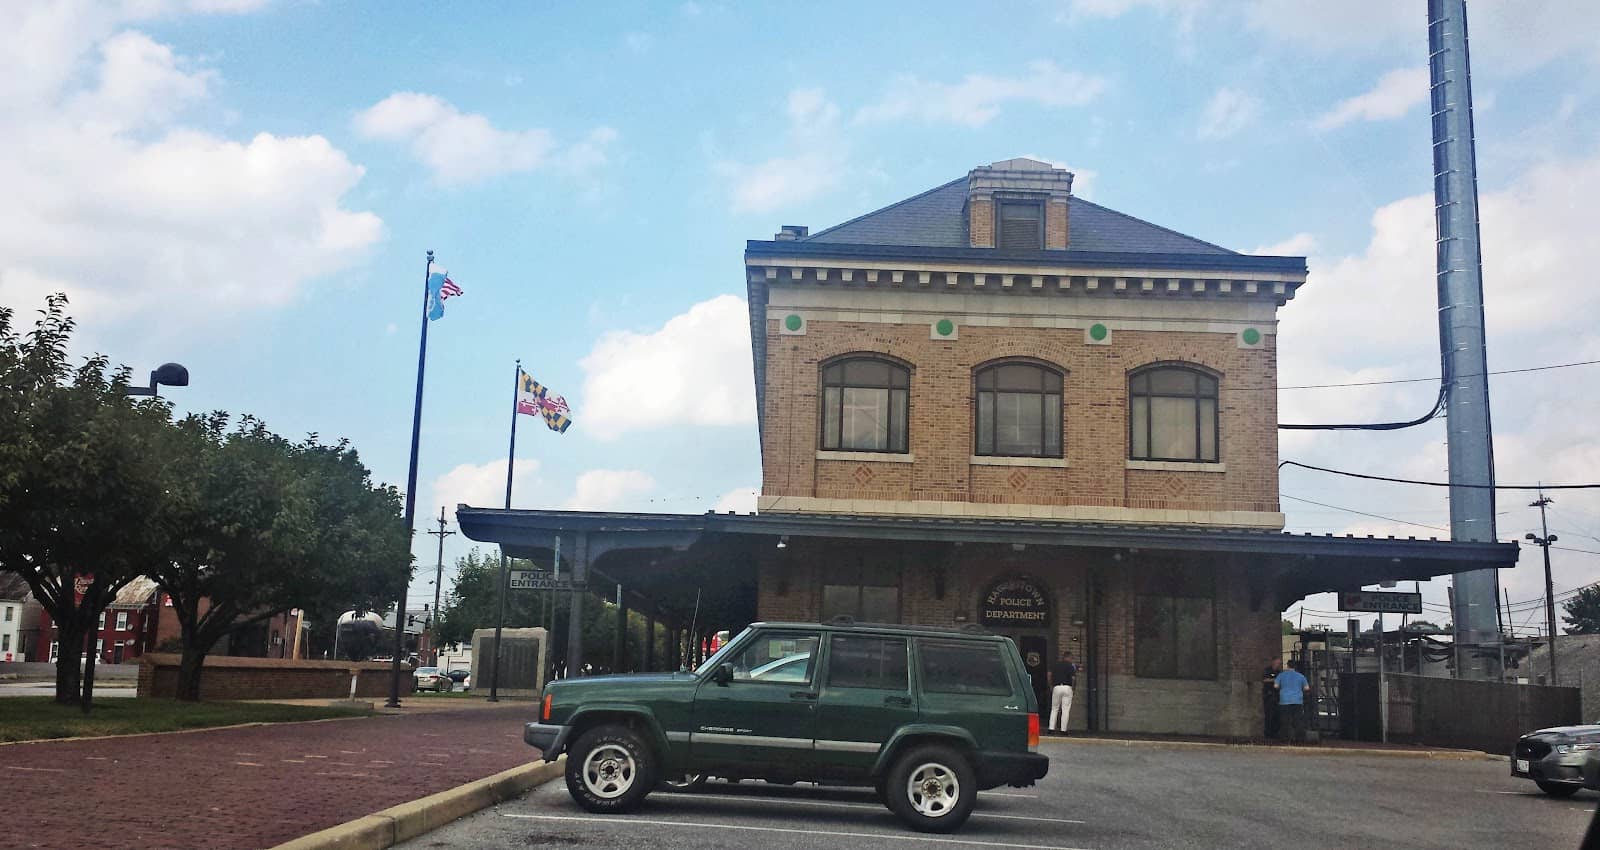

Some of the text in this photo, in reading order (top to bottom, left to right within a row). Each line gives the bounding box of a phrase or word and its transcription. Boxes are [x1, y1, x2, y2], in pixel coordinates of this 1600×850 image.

[520, 572, 556, 580] POLIC
[511, 579, 569, 588] ENTRANCE
[1000, 597, 1032, 607] POLICE
[1363, 601, 1420, 610] ENTRANCE
[985, 610, 1046, 620] DEPARTMENT
